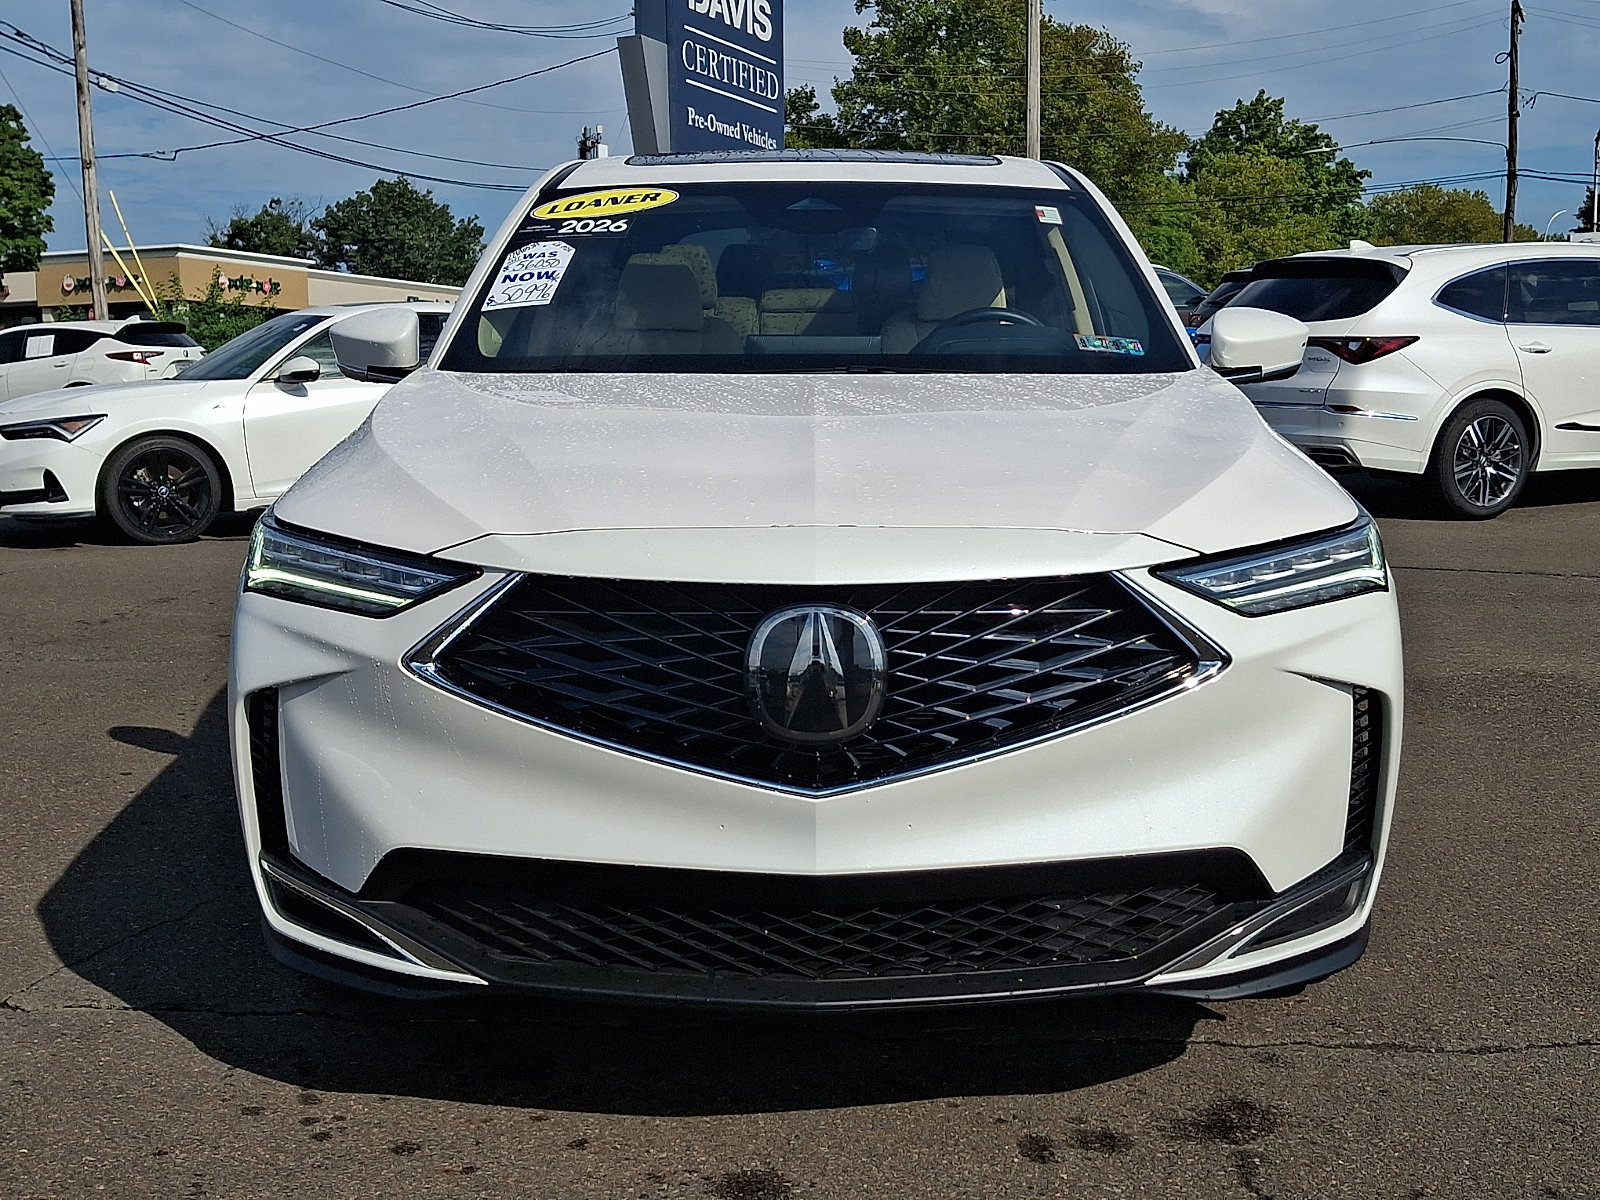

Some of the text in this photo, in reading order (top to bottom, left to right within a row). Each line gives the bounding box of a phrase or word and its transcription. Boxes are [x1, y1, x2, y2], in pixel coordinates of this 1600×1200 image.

[682, 40, 779, 100] CERTIFIED
[687, 106, 777, 150] Pre-Owned Vehicles
[547, 192, 662, 215] LOANER
[557, 219, 629, 234] 2026
[523, 251, 558, 260] WAS
[501, 270, 558, 284] NOW
